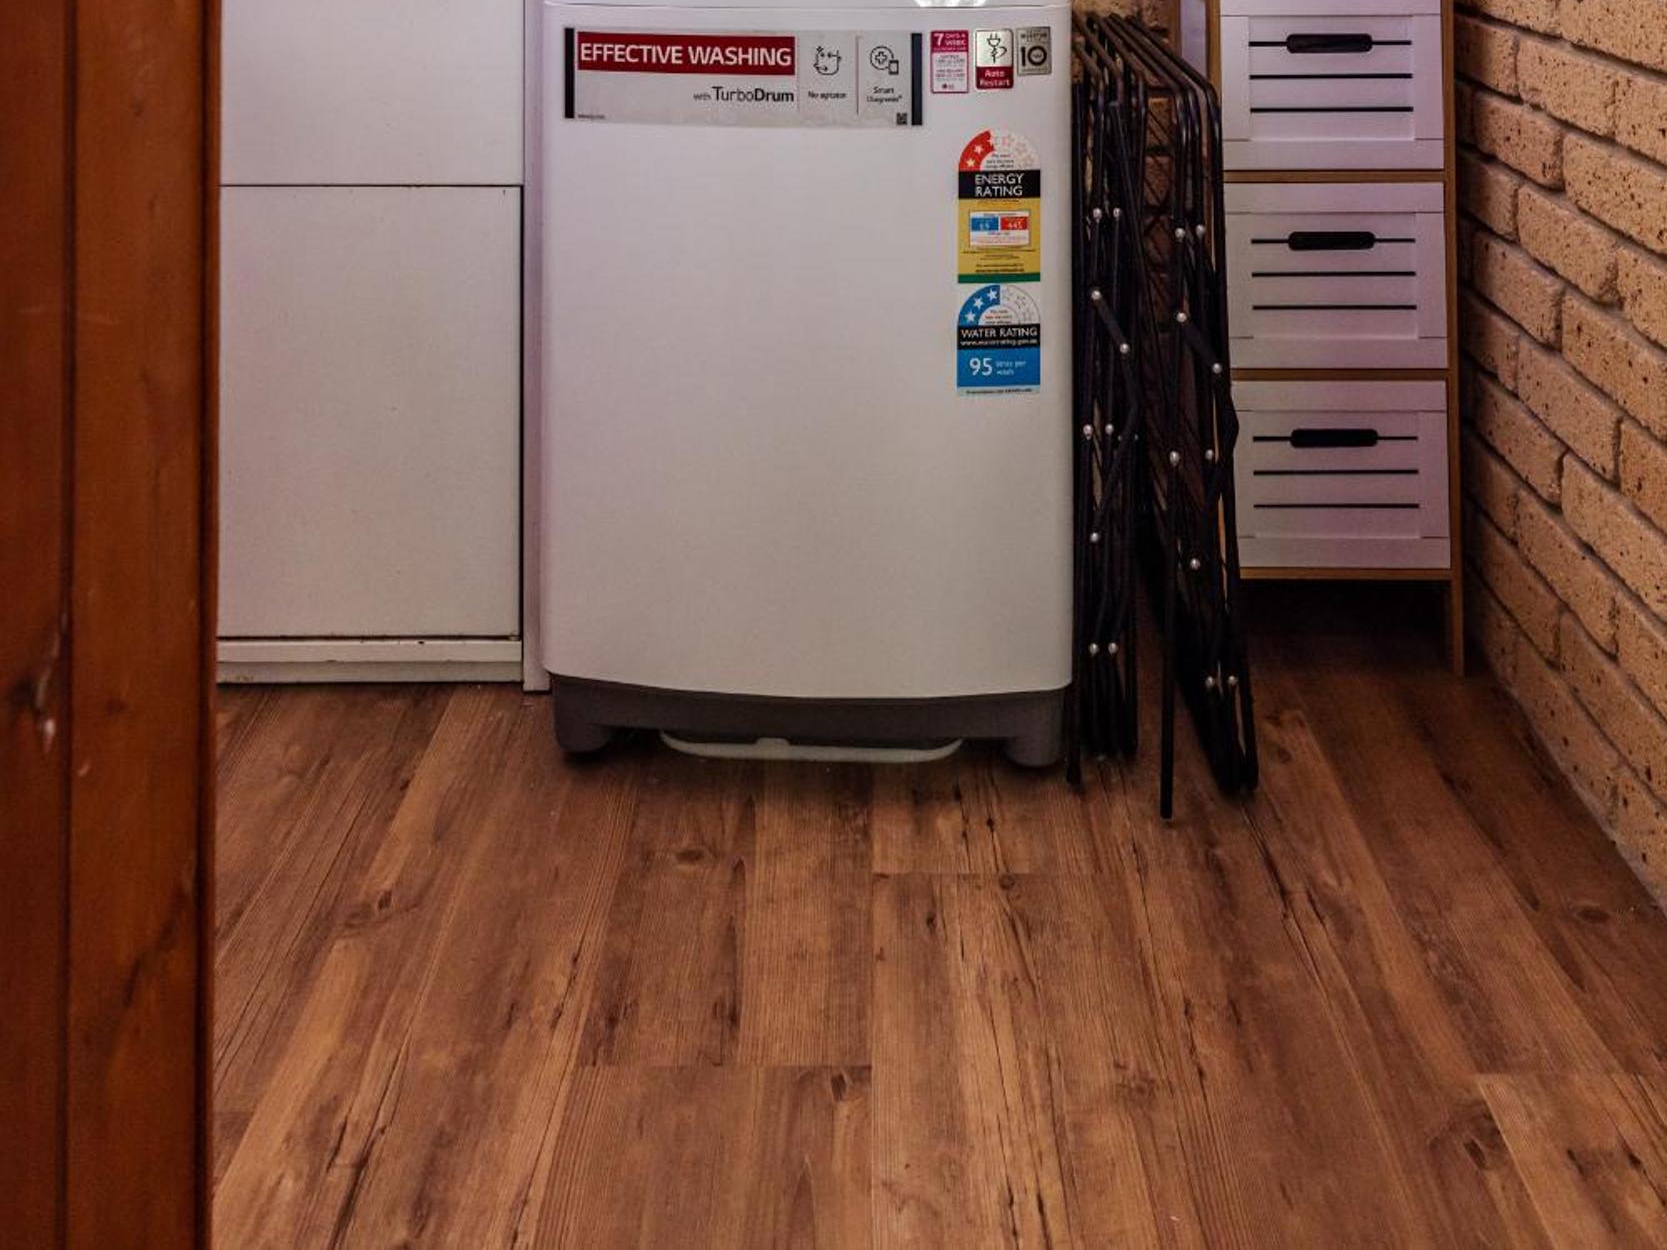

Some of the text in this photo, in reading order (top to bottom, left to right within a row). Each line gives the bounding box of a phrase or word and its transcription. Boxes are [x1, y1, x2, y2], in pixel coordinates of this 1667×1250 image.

[933, 33, 944, 47] 7
[580, 42, 791, 67] EFFECTIVE WASHING
[979, 78, 1010, 87] Restart
[712, 86, 795, 103] TurboDrum
[975, 174, 1024, 185] ENERGY
[974, 186, 1023, 197] RATING
[960, 326, 1037, 339] WATER RATING
[969, 357, 993, 377] 95
